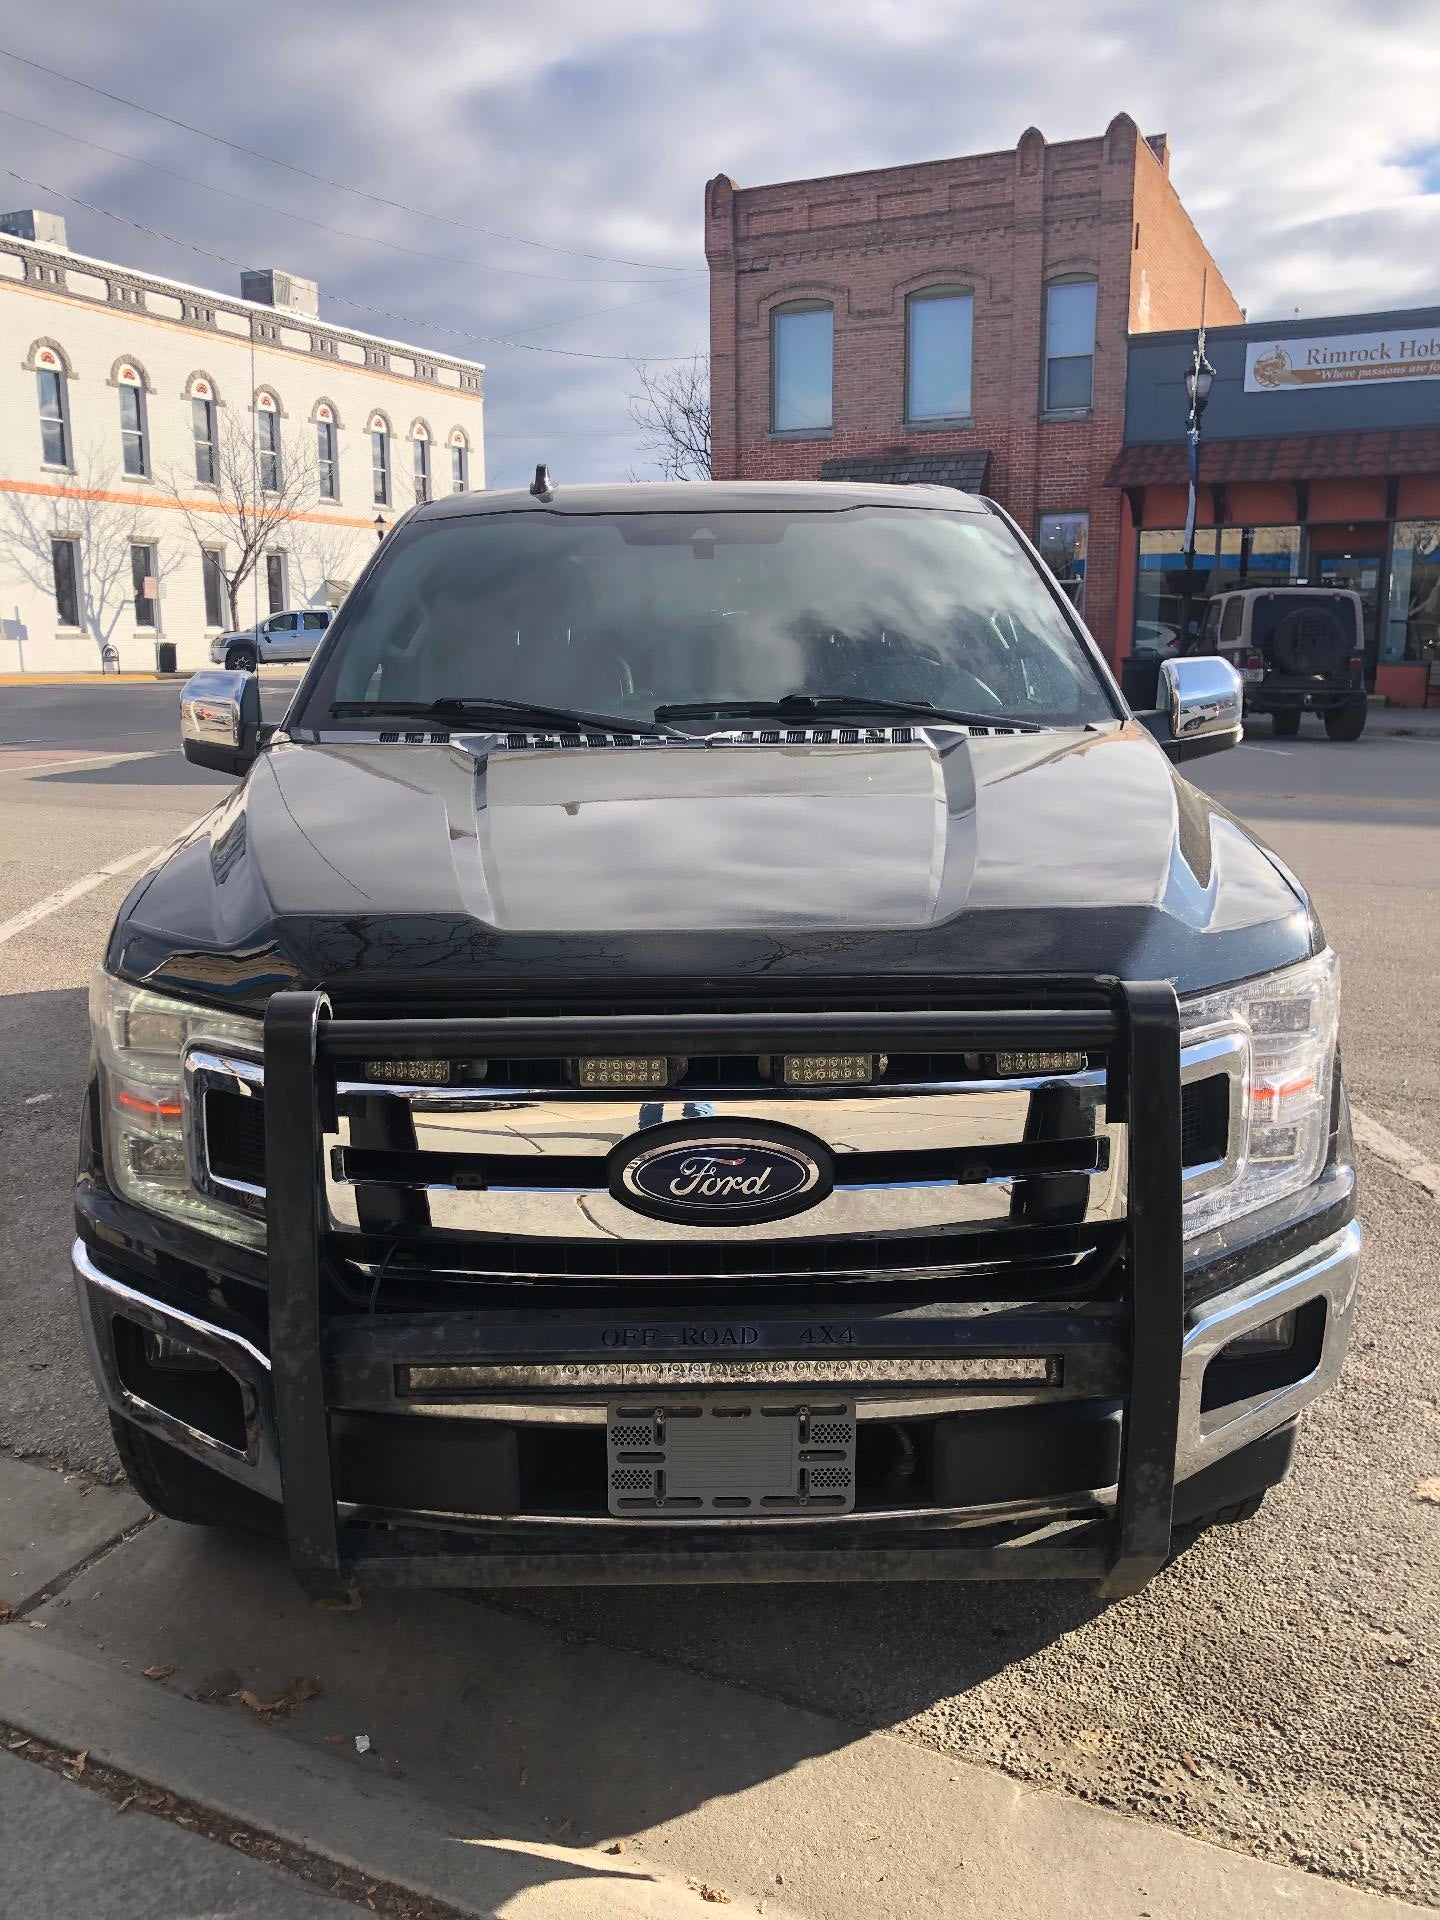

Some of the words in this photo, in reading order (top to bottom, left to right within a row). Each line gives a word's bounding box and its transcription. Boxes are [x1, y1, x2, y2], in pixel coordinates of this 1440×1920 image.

[1306, 342, 1392, 366] Rimrock
[1357, 364, 1406, 380] passions
[1408, 363, 1425, 374] are
[669, 1156, 773, 1196] Ford
[800, 1325, 856, 1344] 4X4
